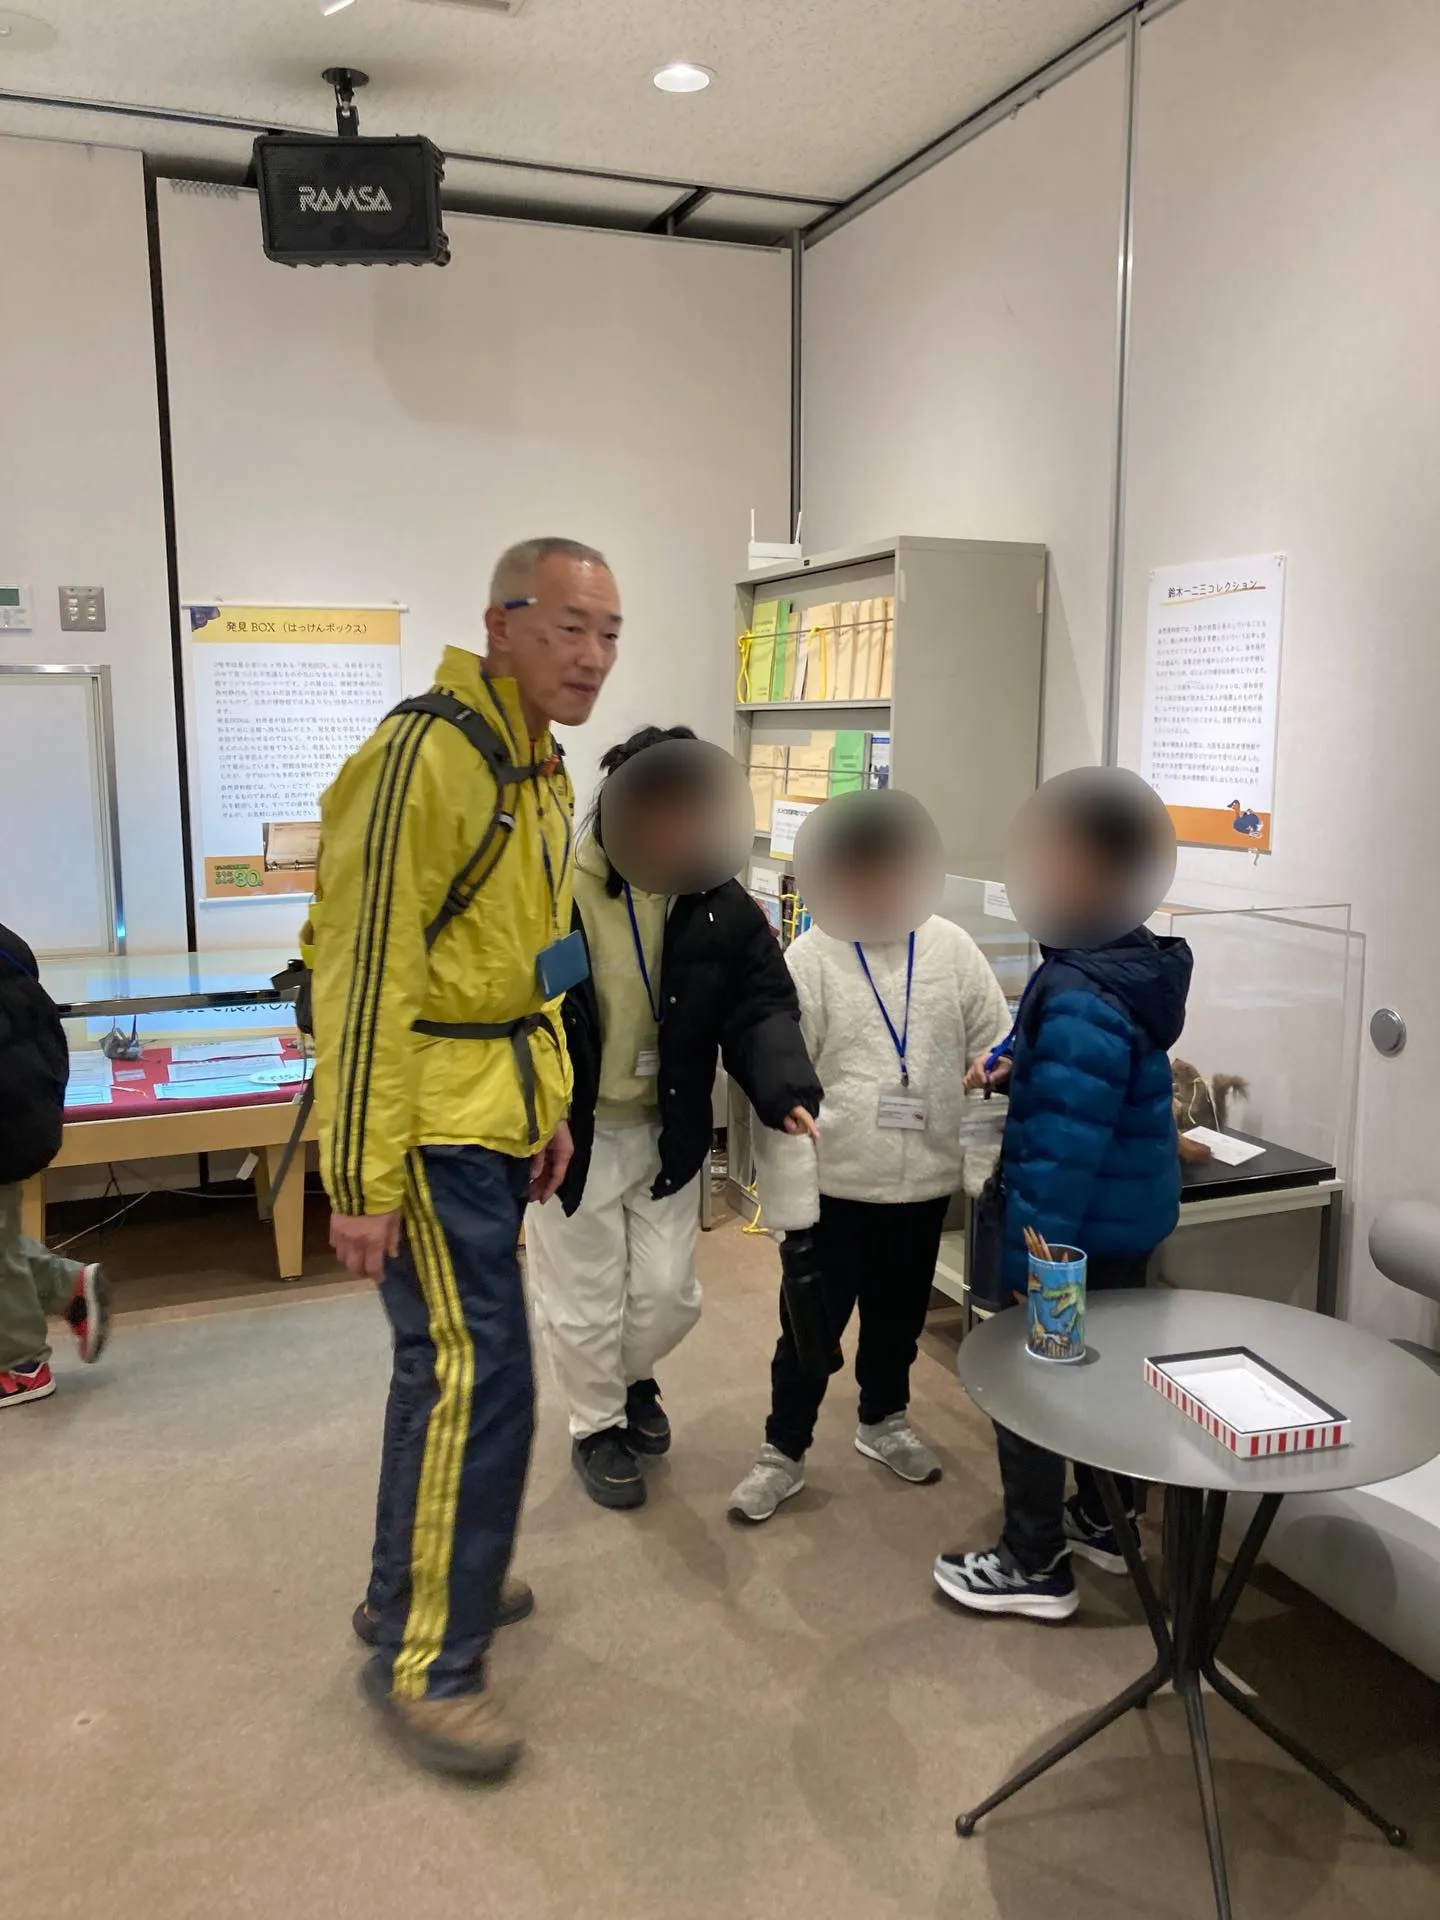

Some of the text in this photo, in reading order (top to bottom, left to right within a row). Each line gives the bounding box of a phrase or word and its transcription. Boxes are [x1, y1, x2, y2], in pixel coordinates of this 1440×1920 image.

[298, 185, 392, 212] RAMSA
[1168, 581, 1257, 598] 鈴木一二三コレクション
